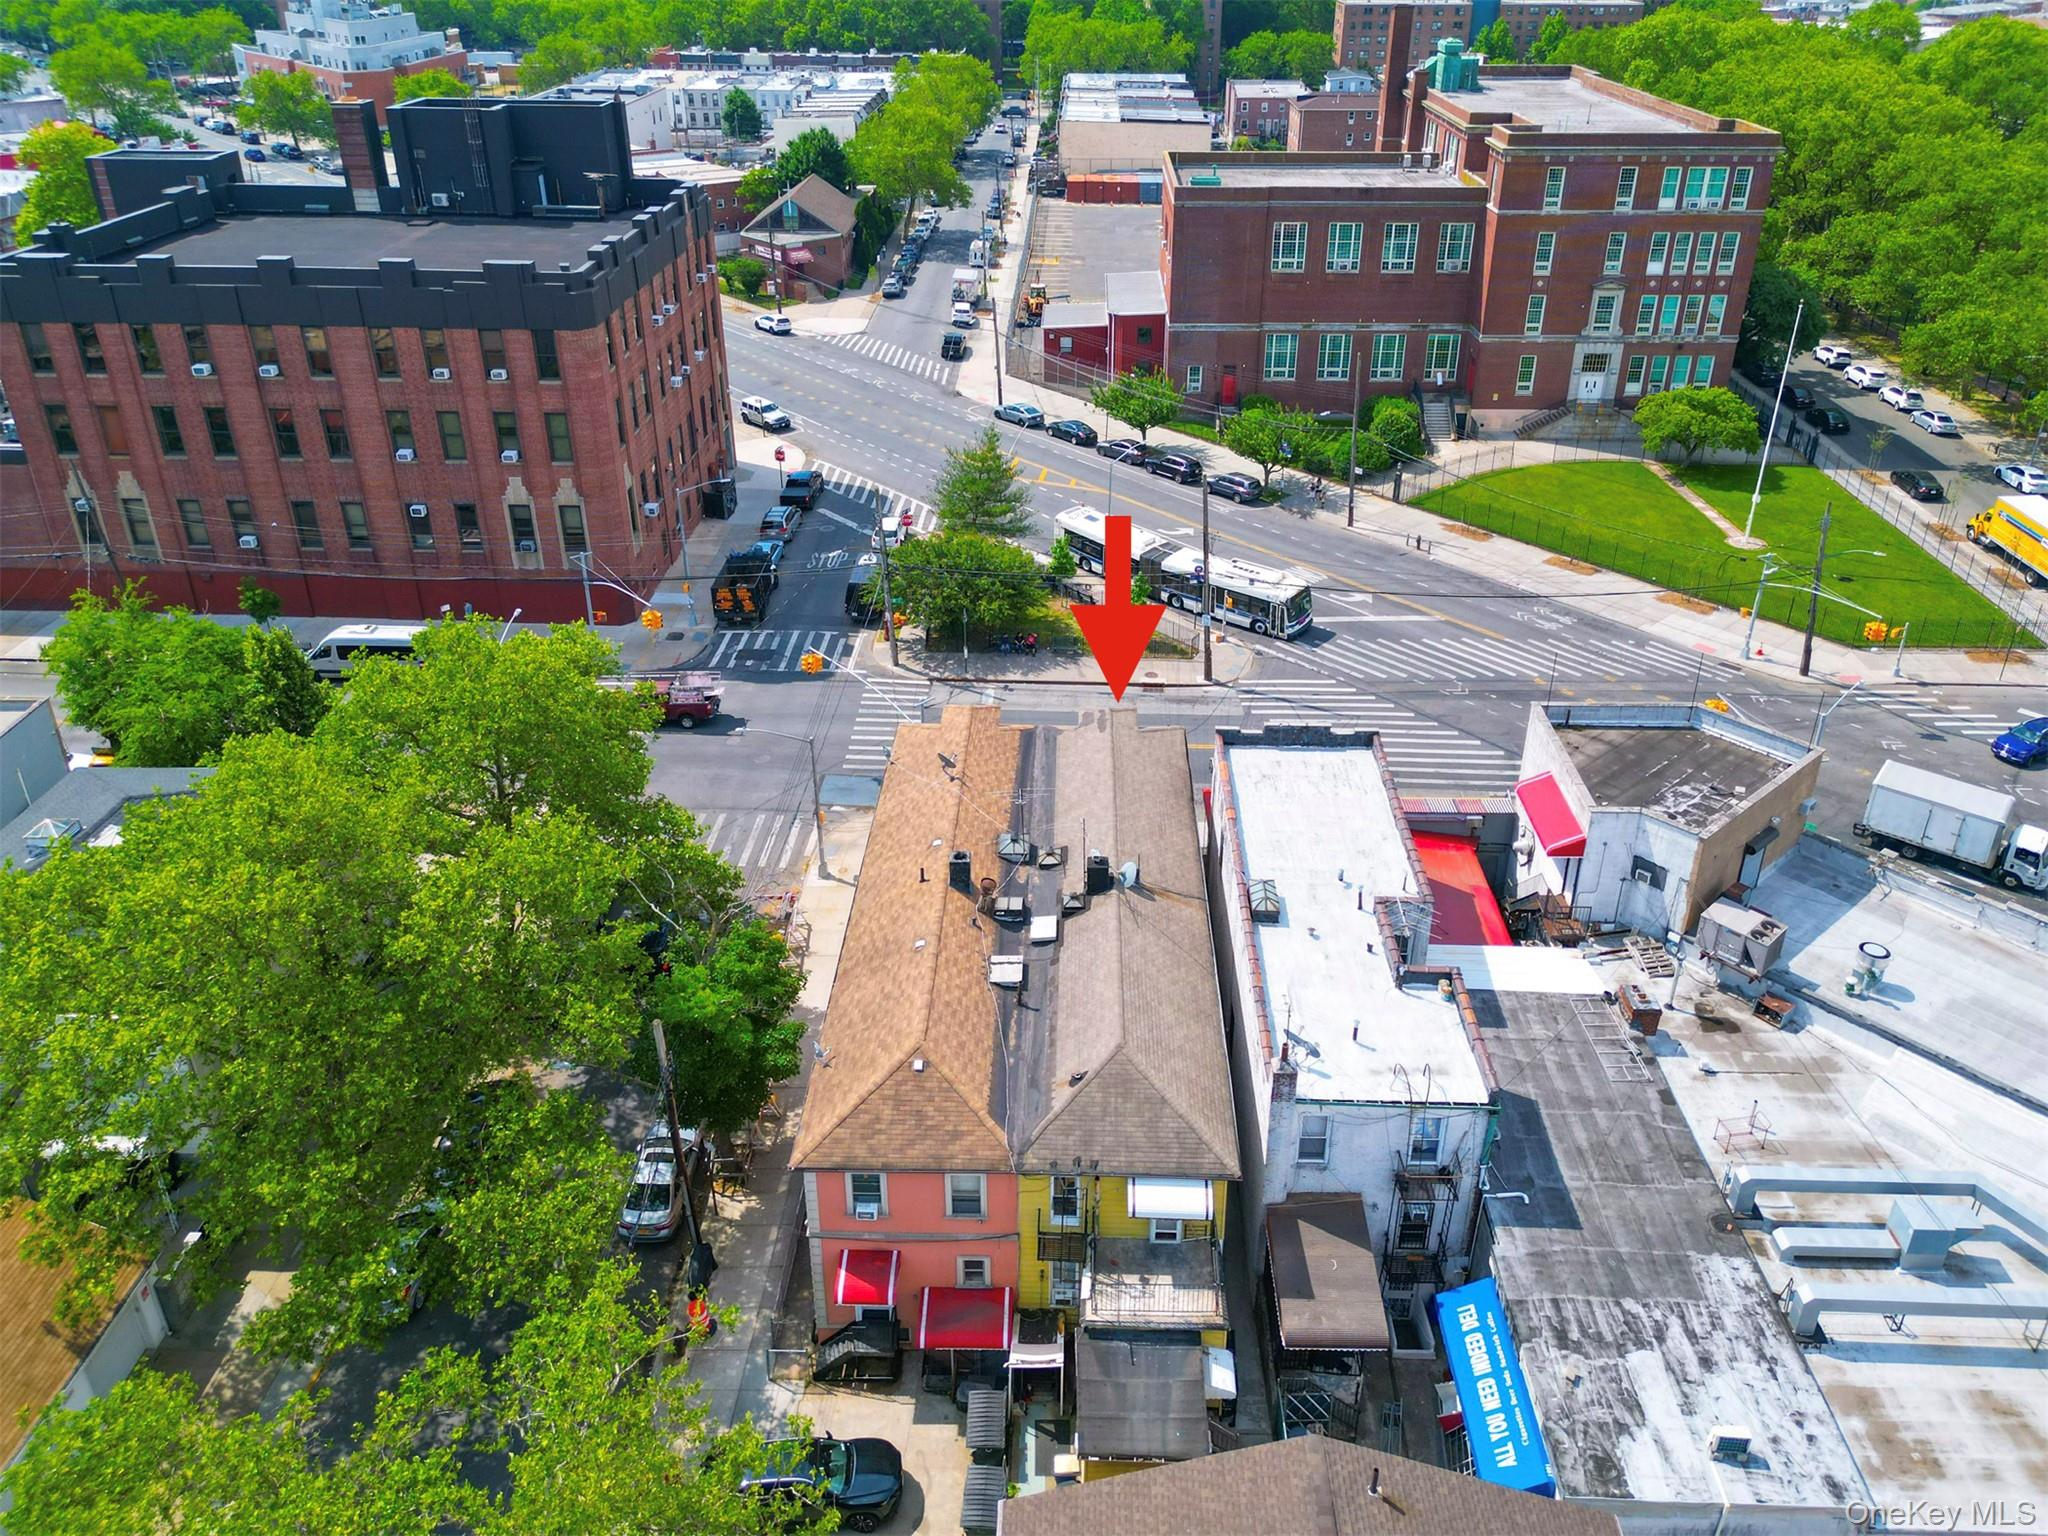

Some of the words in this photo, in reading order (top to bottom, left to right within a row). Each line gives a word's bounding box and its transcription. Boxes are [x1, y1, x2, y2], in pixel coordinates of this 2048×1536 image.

[806, 552, 849, 569] STOP
[1456, 1303, 1480, 1332] DELI
[1464, 1332, 1493, 1377] INDEED
[1476, 1377, 1502, 1412] NEED
[1485, 1412, 1510, 1442] YOU
[1493, 1441, 1518, 1468] ALL
